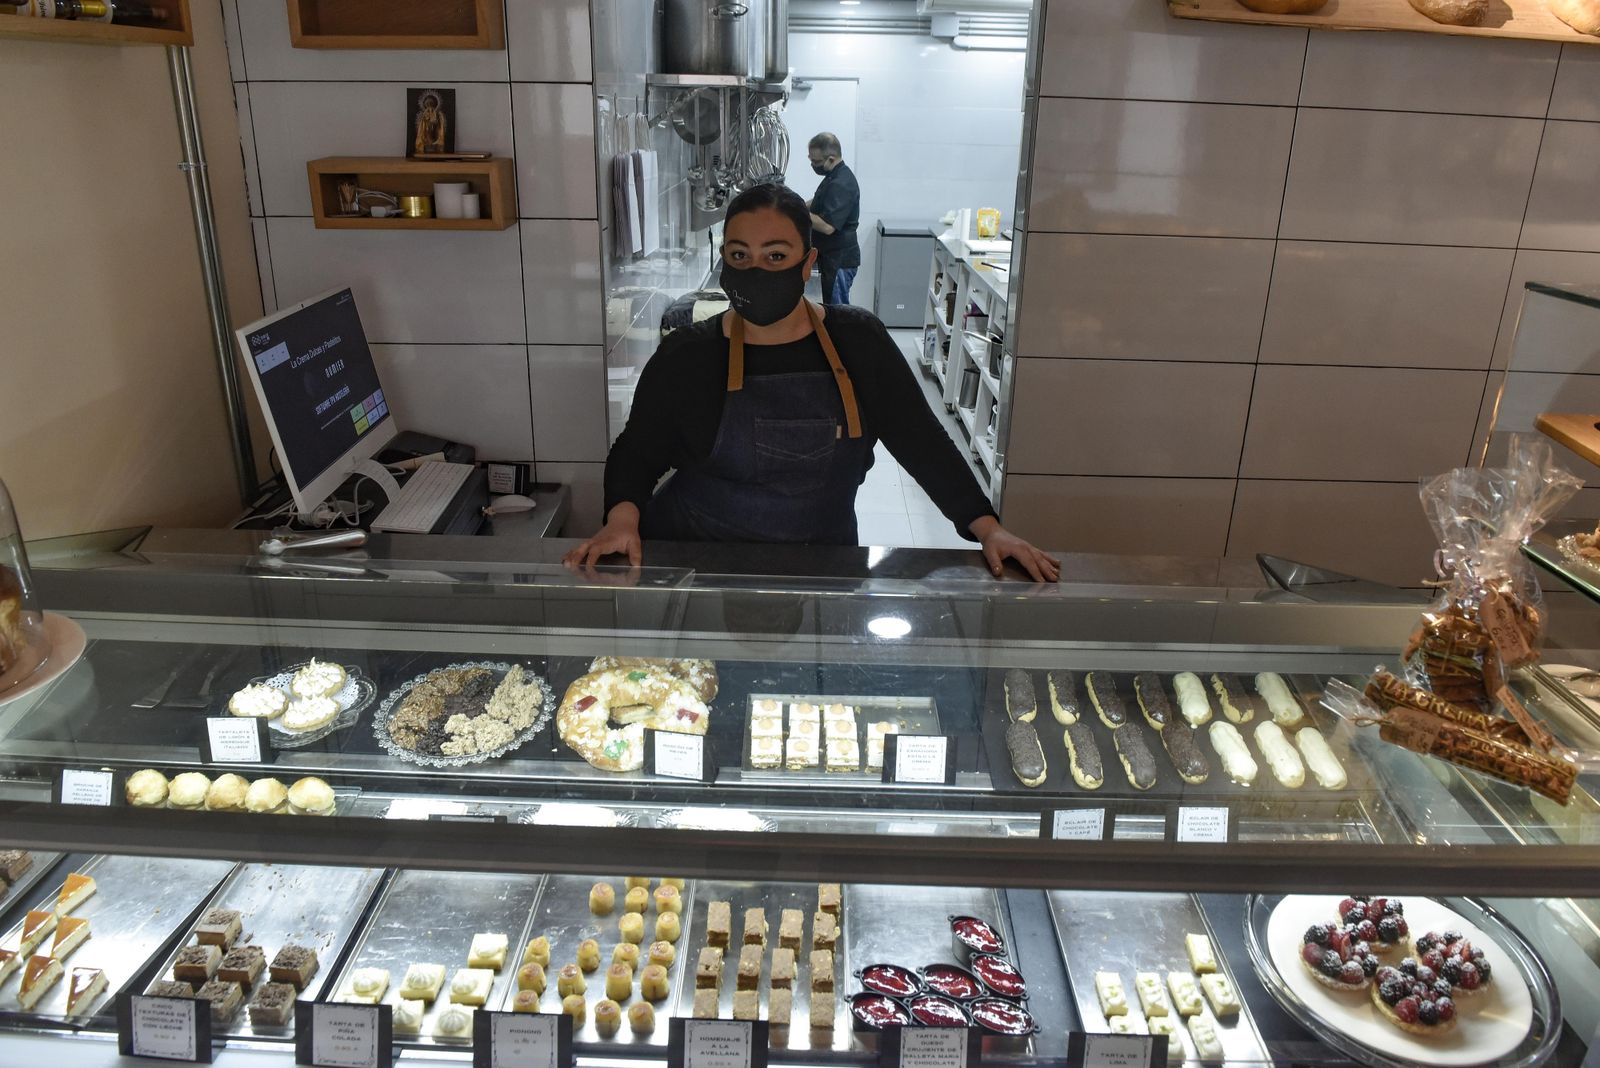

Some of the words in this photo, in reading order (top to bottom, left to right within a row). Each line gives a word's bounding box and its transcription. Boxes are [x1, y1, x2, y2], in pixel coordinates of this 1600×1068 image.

[1416, 689, 1488, 730] CREMA
[138, 1009, 175, 1017] TEXTURAS
[141, 1015, 183, 1024] CHOCOLATE
